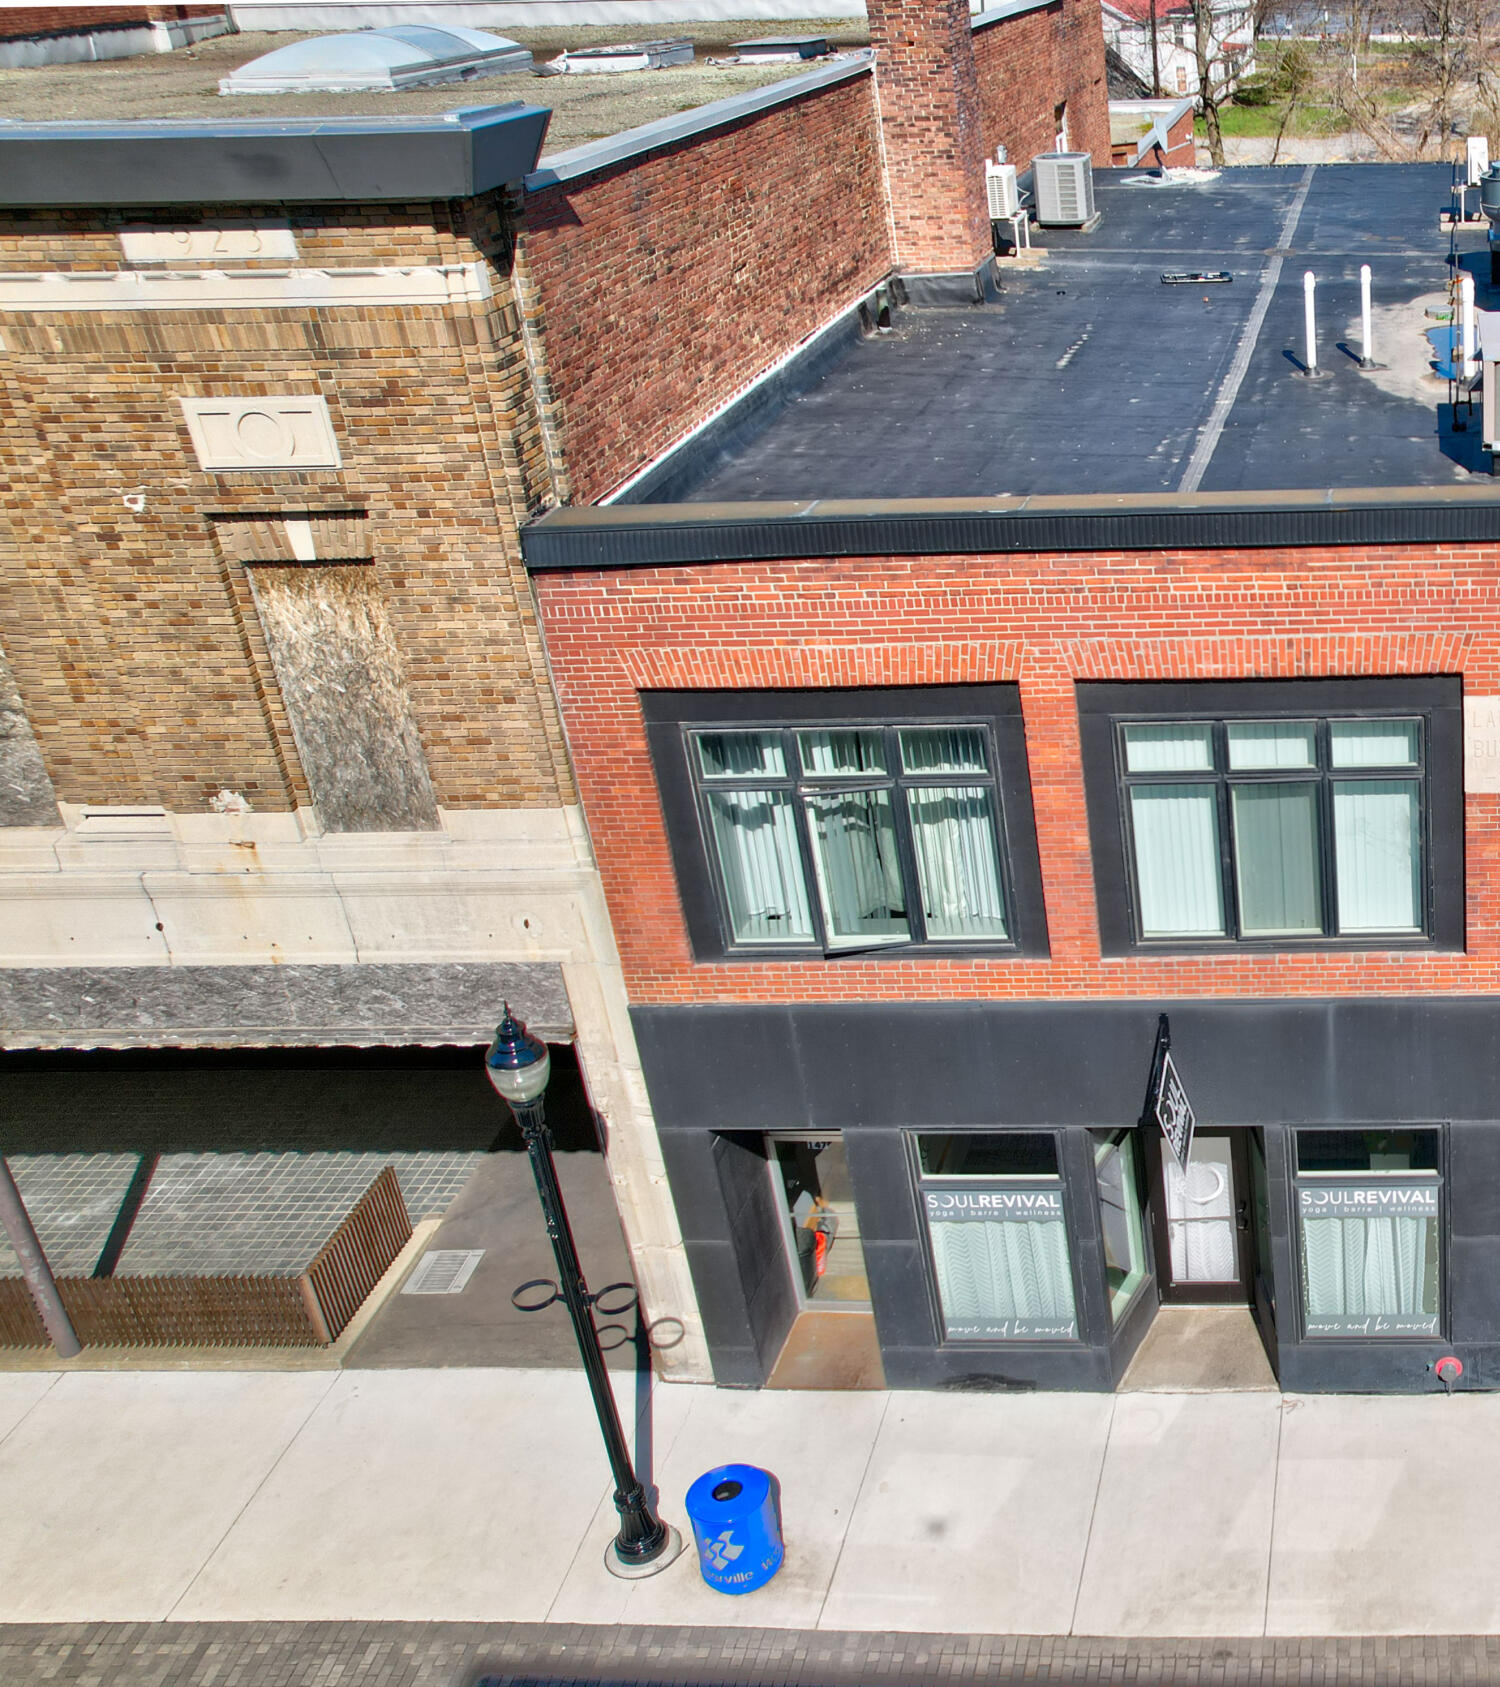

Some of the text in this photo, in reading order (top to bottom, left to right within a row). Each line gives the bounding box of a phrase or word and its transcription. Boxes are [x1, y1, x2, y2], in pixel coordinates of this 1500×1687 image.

[1302, 1206, 1327, 1214] yoga
[1344, 1205, 1372, 1213] barre
[947, 1320, 1074, 1337] move and be moved
[1307, 1316, 1437, 1334] move and be moved
